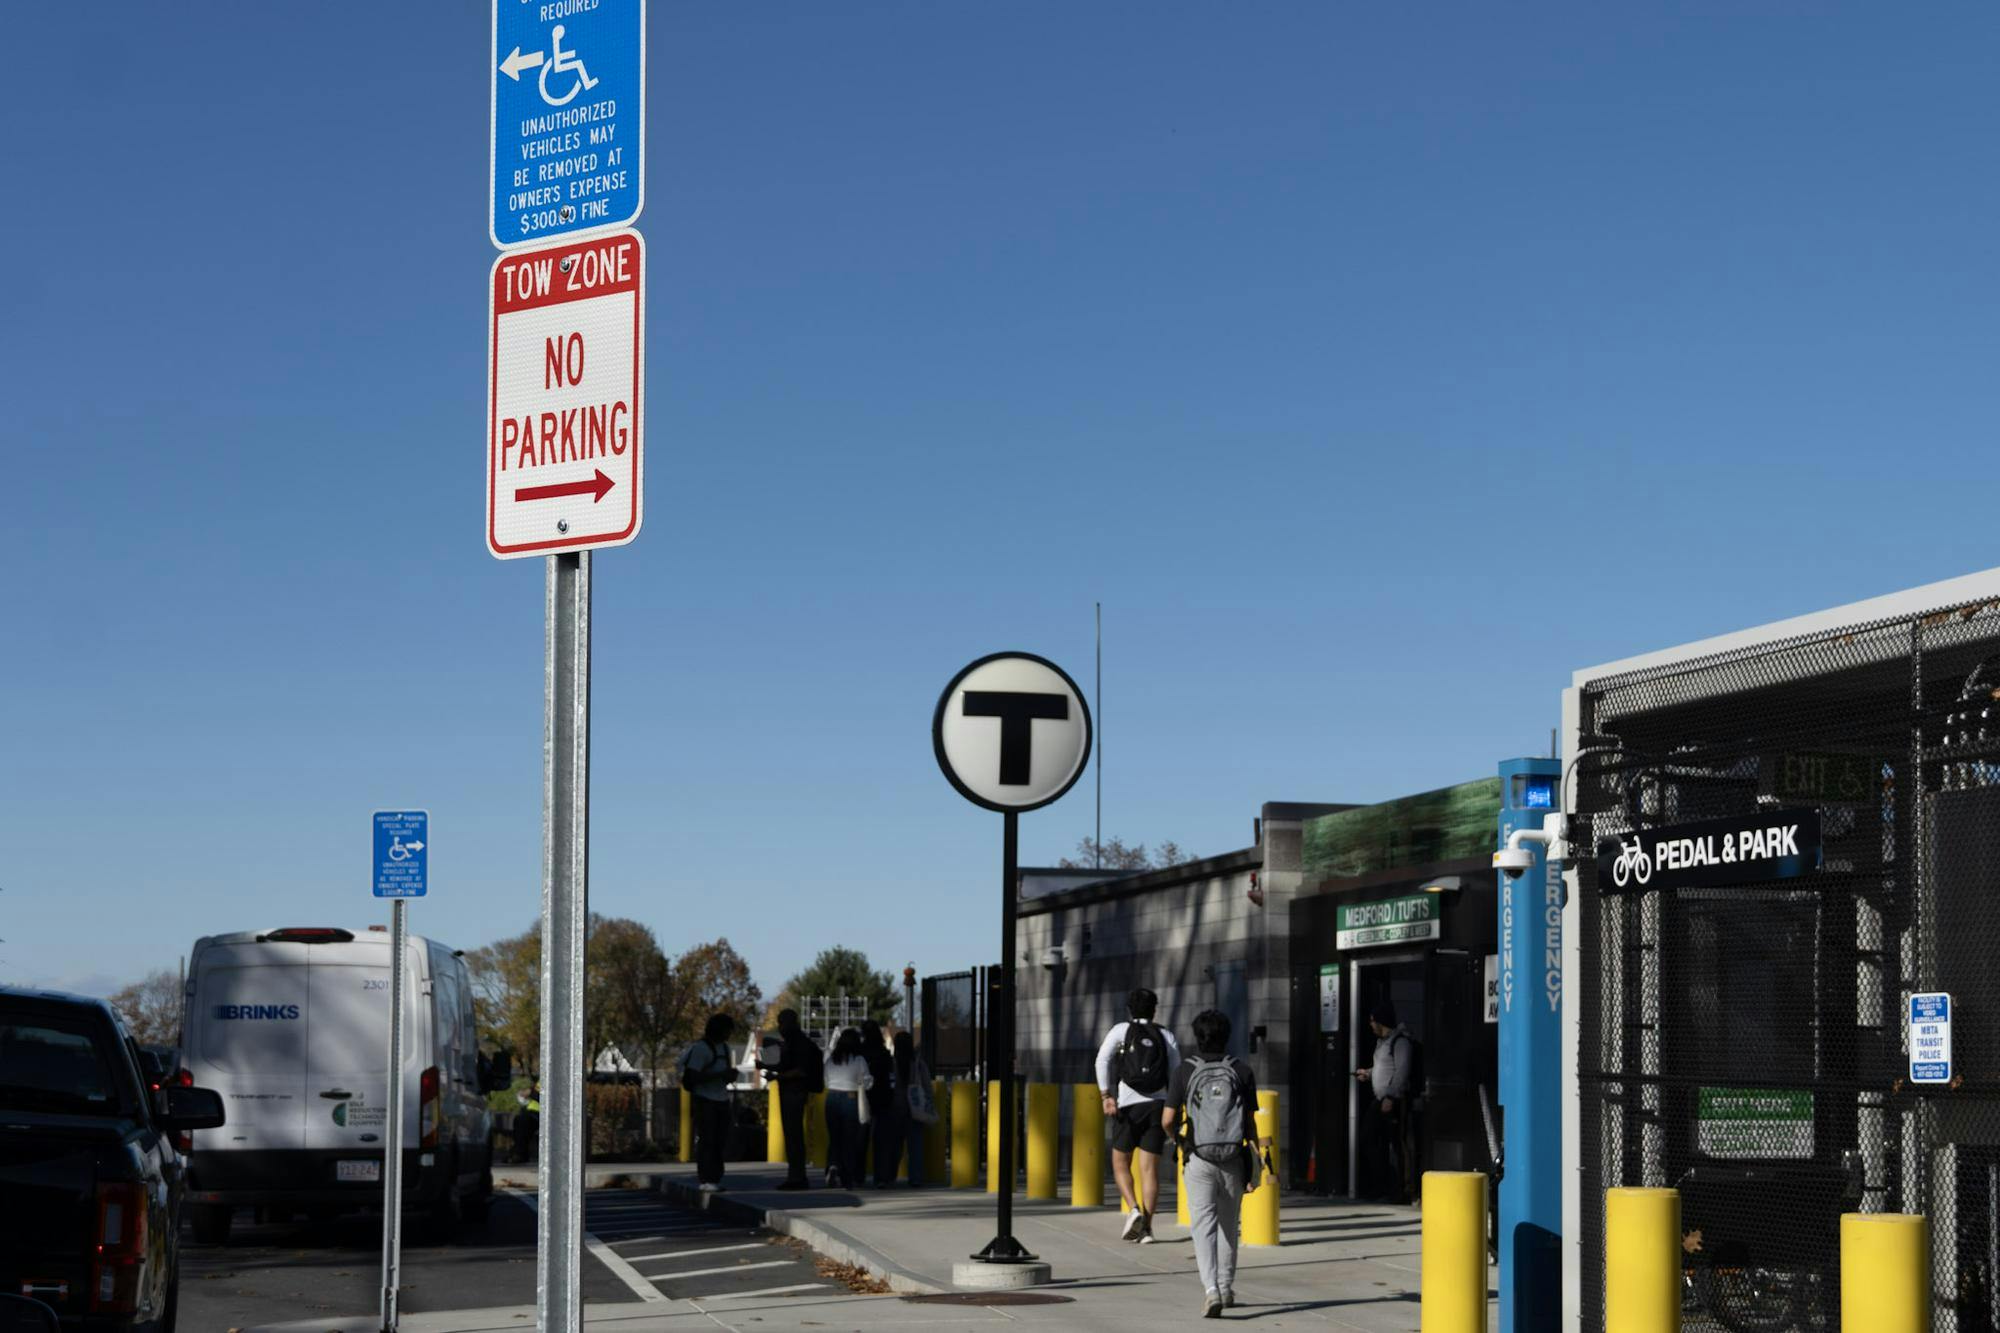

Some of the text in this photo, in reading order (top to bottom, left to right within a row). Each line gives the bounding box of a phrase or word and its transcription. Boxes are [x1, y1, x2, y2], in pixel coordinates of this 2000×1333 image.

[541, 0, 599, 22] REQUIRED
[521, 100, 616, 137] UNAUTHORIZED
[521, 124, 616, 160] VEHICLES MAY
[514, 148, 623, 187] BE REMOVED AT
[509, 171, 627, 212] OWNER'S EXPENSE
[582, 198, 610, 221] FINE
[503, 244, 631, 302] TOW ZONE
[545, 332, 584, 390] NO
[502, 401, 627, 471] PARKING
[963, 691, 1068, 786] T
[1656, 824, 1799, 871] PEDAL & PARK
[1345, 898, 1429, 928] MEDFORD/TUFTS
[363, 980, 389, 990] 2301
[227, 1005, 300, 1020] BRINKS
[1920, 1026, 1938, 1034] MBTA
[1916, 1038, 1943, 1047] TRANSIT
[1919, 1050, 1941, 1059] POLICE
